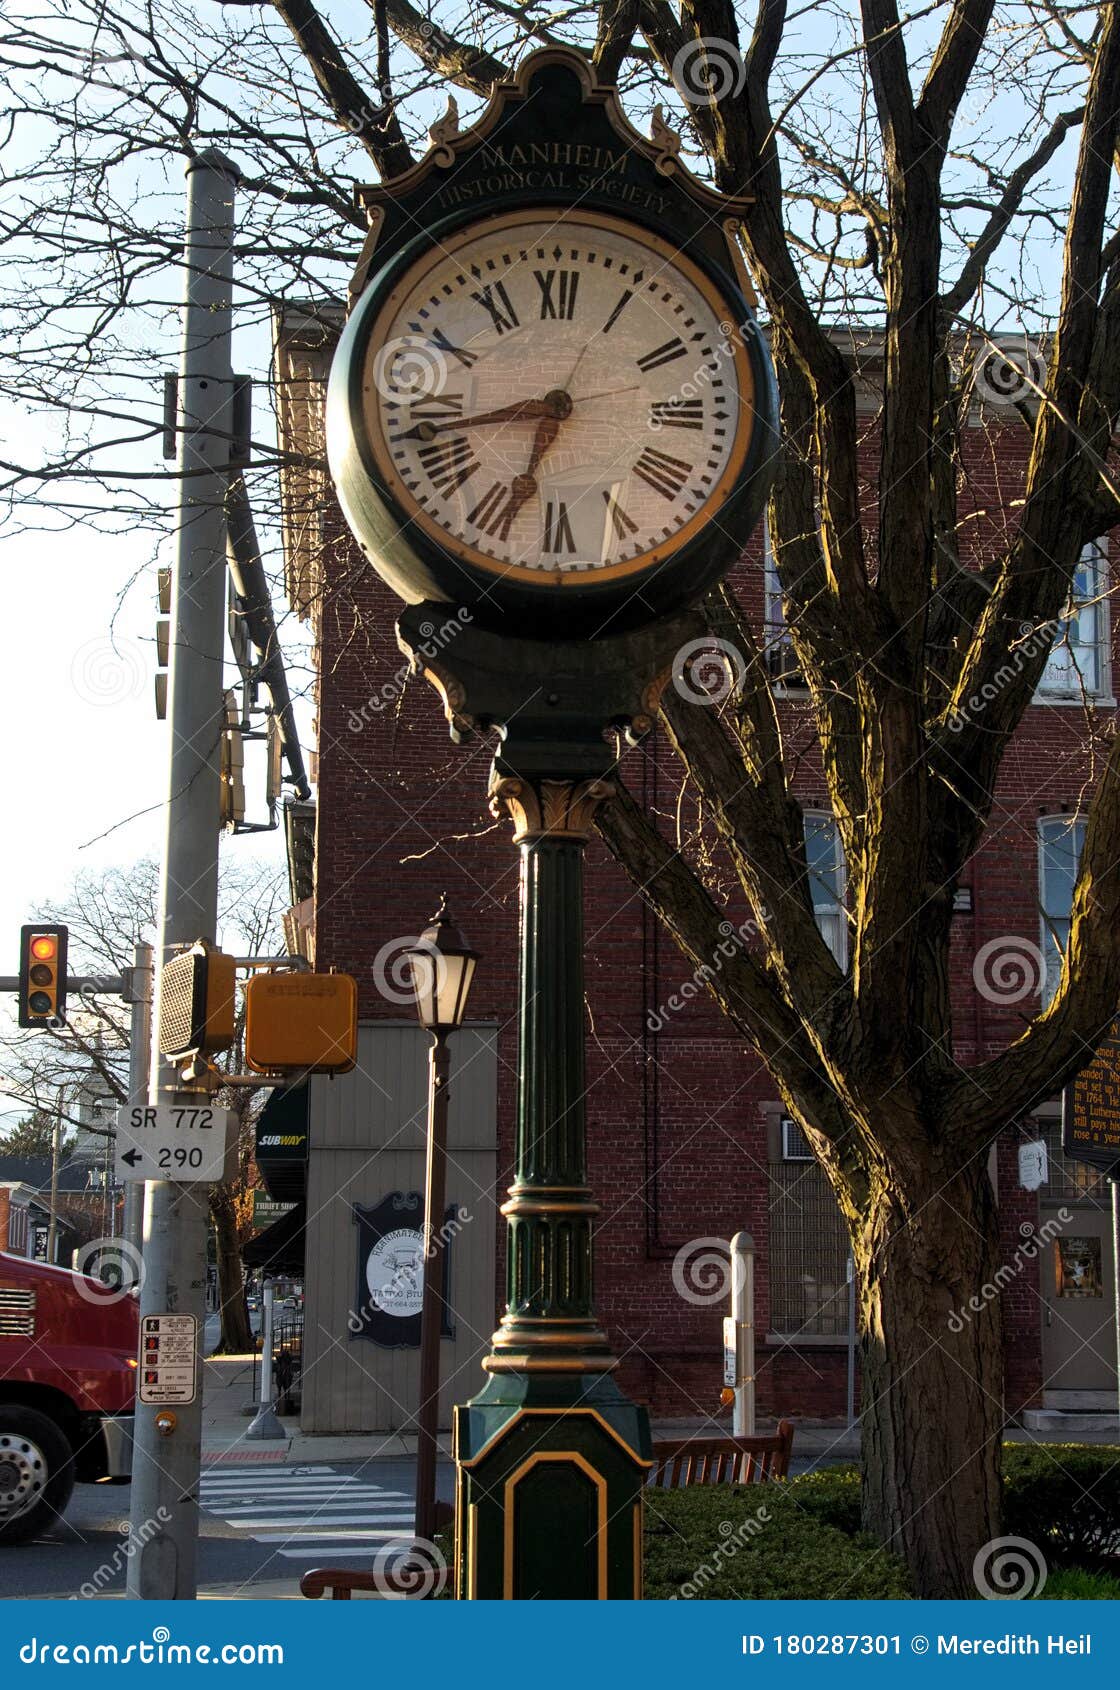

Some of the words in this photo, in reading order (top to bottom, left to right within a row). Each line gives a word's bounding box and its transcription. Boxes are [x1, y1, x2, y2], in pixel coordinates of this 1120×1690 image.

[480, 142, 629, 175] MANHEIM
[439, 171, 571, 209] HISTORICAL
[577, 174, 672, 215] SOCIETY
[533, 270, 579, 320] XII
[470, 281, 520, 335] XI
[1077, 1070, 1103, 1081] ounded
[130, 1107, 157, 1129] SR
[171, 1109, 213, 1129] 772
[1074, 1103, 1086, 1114] the
[259, 1135, 306, 1146] SUBWAY
[1074, 1130, 1090, 1140] rose
[158, 1148, 203, 1168] 290
